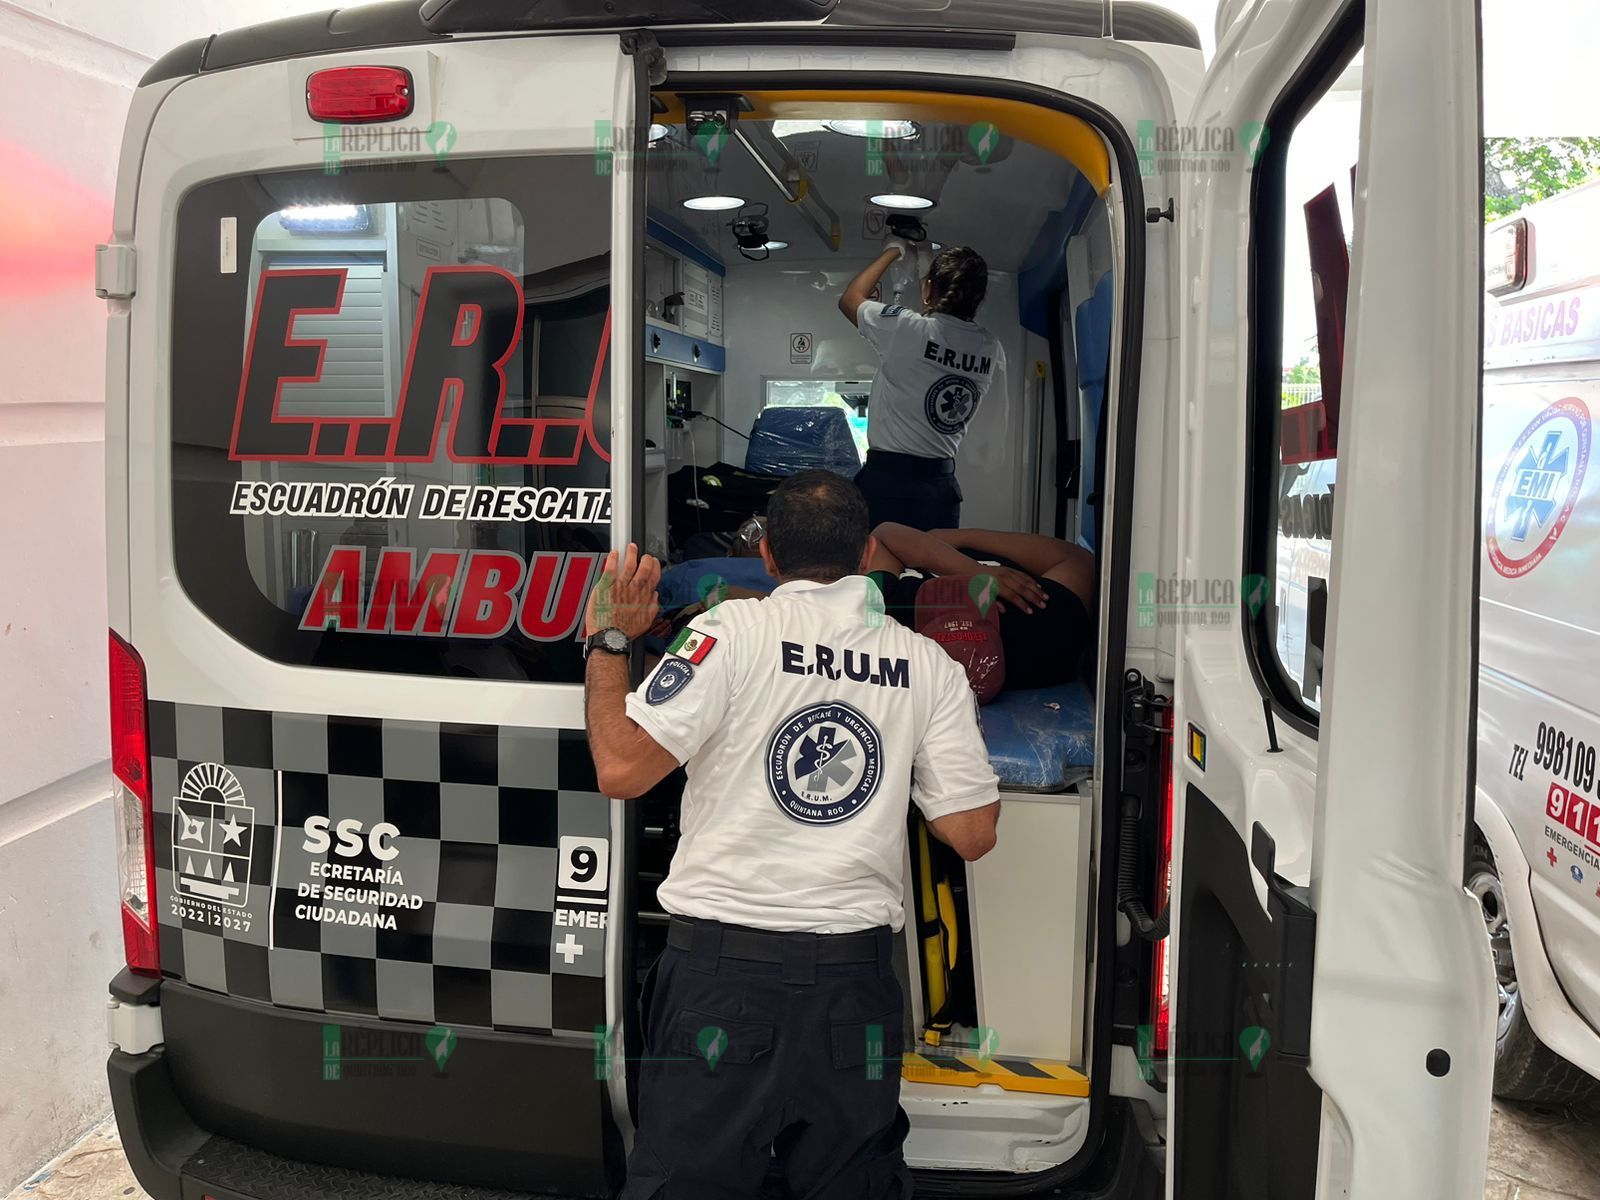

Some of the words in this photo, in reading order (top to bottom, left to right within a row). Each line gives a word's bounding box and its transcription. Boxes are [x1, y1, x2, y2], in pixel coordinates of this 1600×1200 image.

[1500, 297, 1581, 346] BASICAS
[924, 341, 991, 374] E.R.U.M
[230, 476, 414, 519] ESCUADRÓN
[418, 484, 470, 520] DE
[1515, 471, 1555, 500] EMI
[297, 544, 611, 643] AMBU
[781, 640, 910, 689] E.R.U.M
[792, 722, 804, 732] DE
[845, 716, 876, 754] URGENCIAS
[1508, 743, 1529, 782] TEL
[790, 800, 822, 817] QUINTANA
[828, 806, 844, 816] ROO
[302, 815, 400, 861] SSC
[310, 861, 404, 886] ECRETARÍA
[570, 845, 598, 883] 9
[170, 895, 206, 909] GOBIERNO
[207, 904, 222, 912] DEL
[222, 907, 253, 919] ESTADO
[297, 882, 321, 899] DE
[323, 885, 423, 910] SEGURIDAD
[295, 904, 398, 931] CIUDADANA
